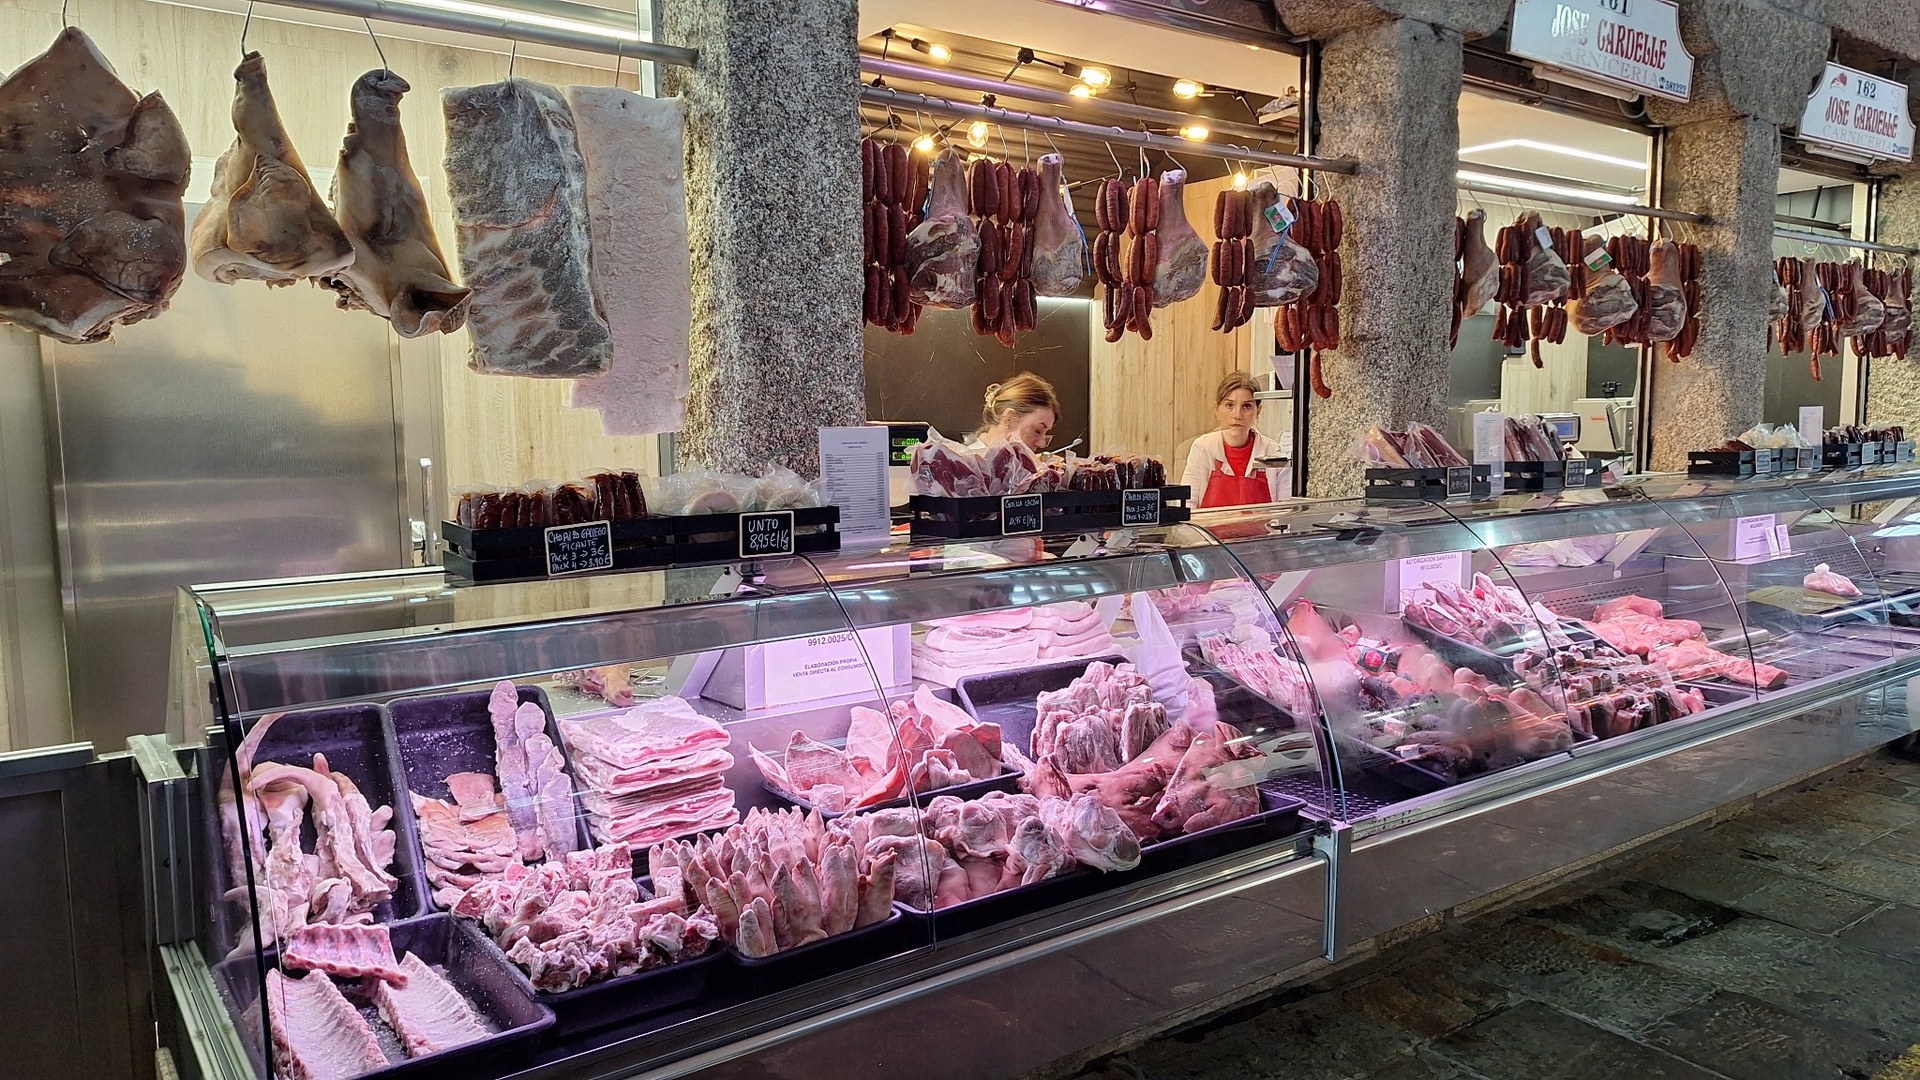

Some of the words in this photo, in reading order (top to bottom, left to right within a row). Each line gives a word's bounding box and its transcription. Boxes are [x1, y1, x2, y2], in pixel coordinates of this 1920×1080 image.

[1552, 3, 1590, 46] JOSE
[1597, 18, 1668, 71] GARDELLE
[1857, 79, 1877, 99] 162
[1825, 96, 1850, 126] JOSE
[1853, 103, 1899, 139] GARDELLE
[748, 518, 779, 533] UNTO
[550, 552, 568, 563] PACK
[571, 552, 577, 561] 3
[552, 561, 570, 572] PACK
[809, 668, 830, 676] DIRECTA
[837, 662, 868, 671] CONSUMIDO
